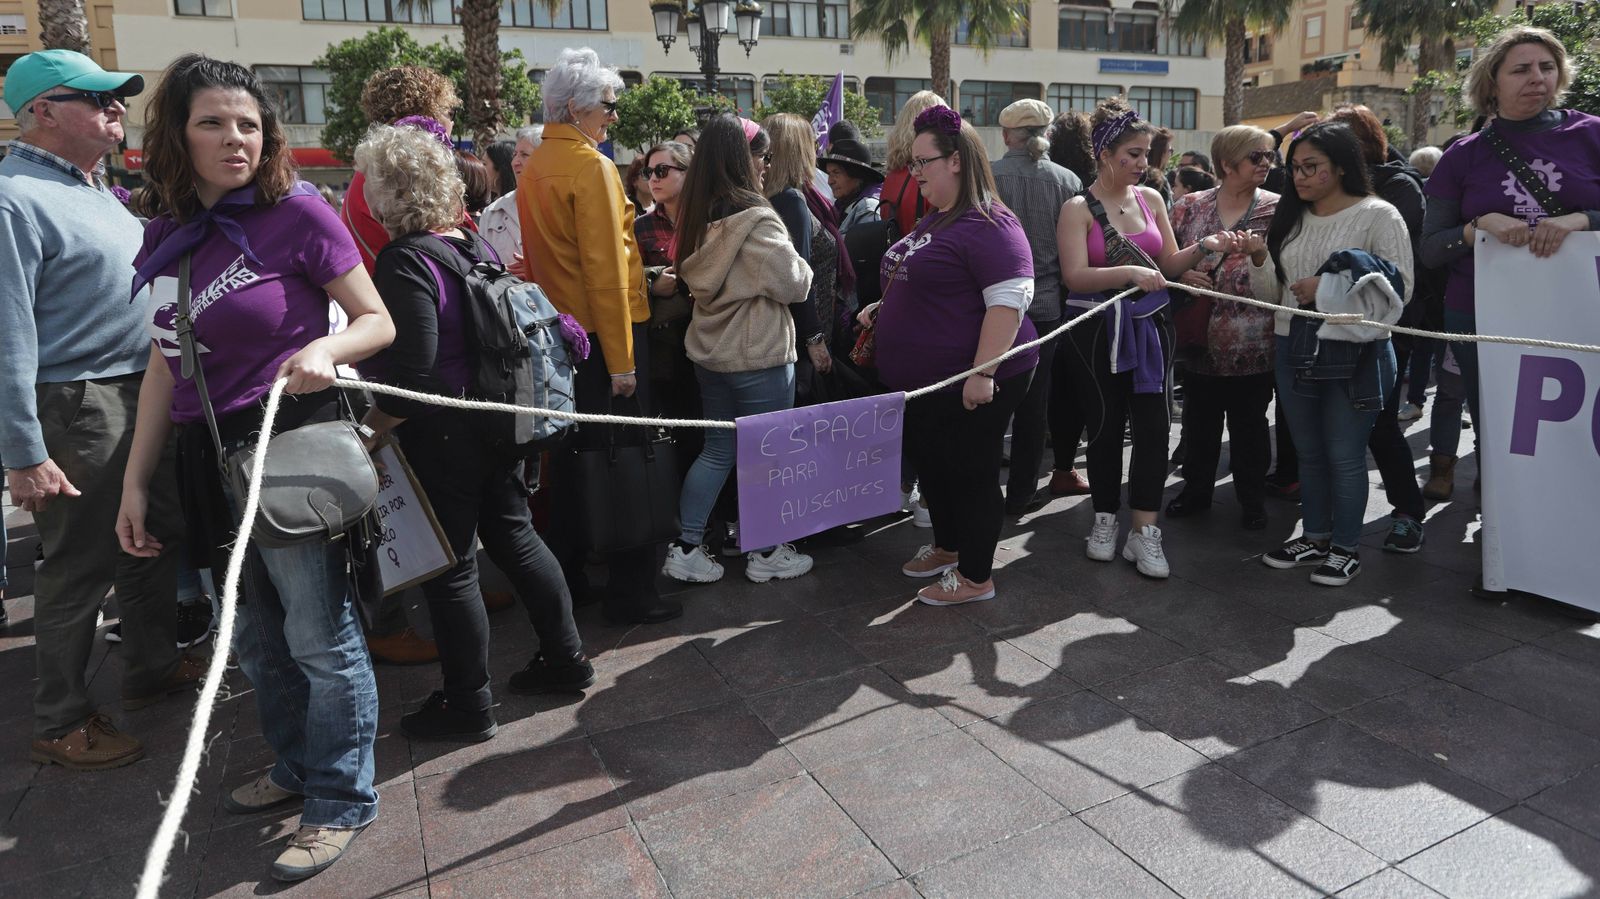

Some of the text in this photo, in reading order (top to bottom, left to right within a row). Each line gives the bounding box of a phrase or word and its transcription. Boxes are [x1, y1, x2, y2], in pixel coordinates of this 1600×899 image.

[1510, 354, 1600, 456] P
[761, 404, 898, 455] ESPACIO
[769, 449, 881, 487] PARA LAS
[389, 496, 406, 513] POR
[781, 480, 884, 524] AUSENTES
